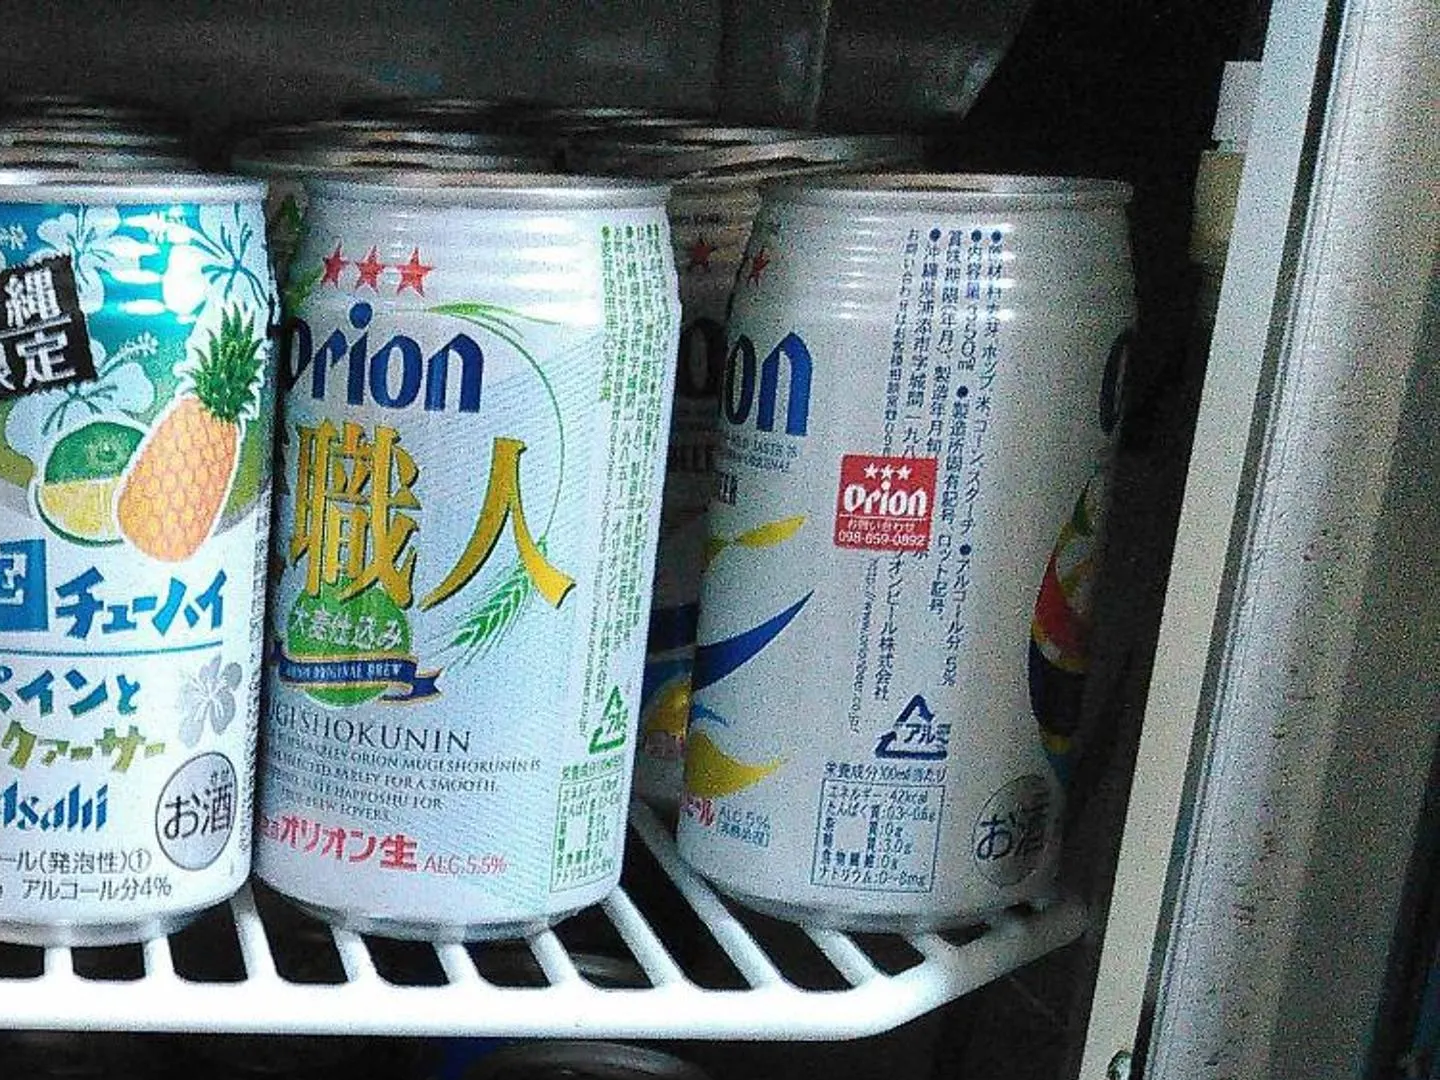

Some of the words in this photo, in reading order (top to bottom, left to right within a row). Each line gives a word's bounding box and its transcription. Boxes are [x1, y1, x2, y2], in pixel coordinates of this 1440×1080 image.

[289, 416, 576, 612] 職人
[843, 481, 929, 519] Orion
[301, 706, 472, 754] SHOKUNIN
[163, 784, 235, 842] お酒
[280, 814, 419, 873] オリオン生
[21, 873, 173, 902] アルコール分4%
